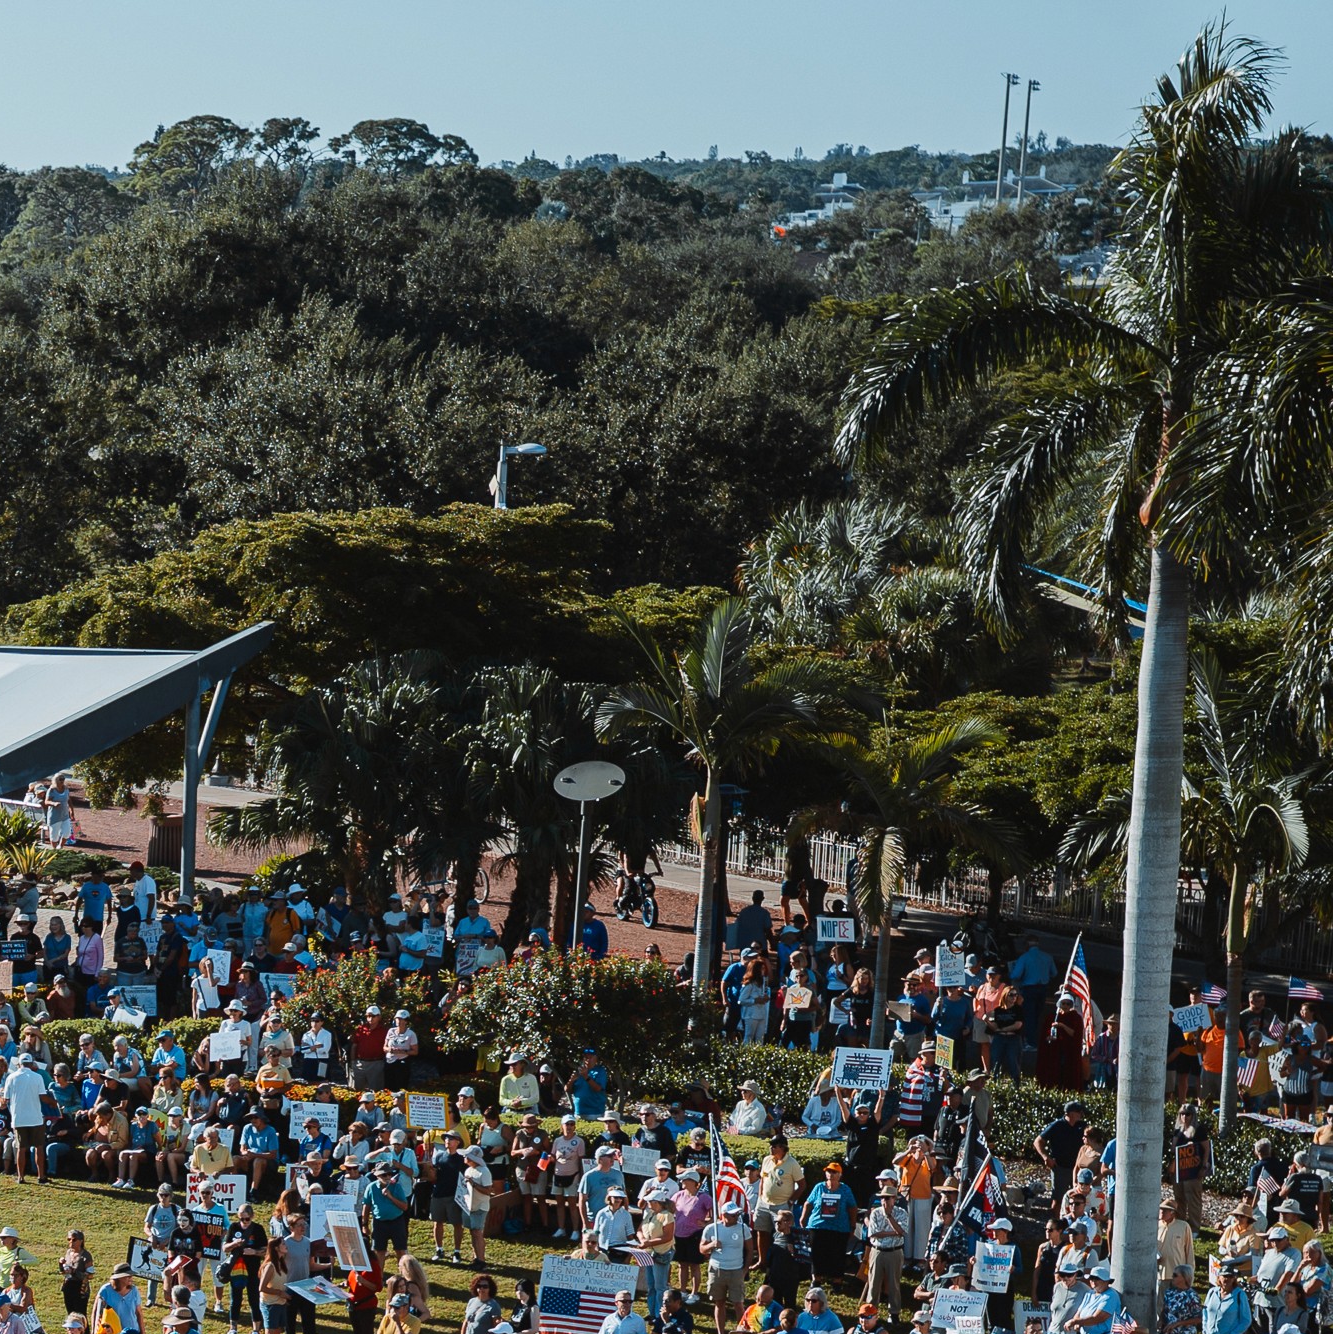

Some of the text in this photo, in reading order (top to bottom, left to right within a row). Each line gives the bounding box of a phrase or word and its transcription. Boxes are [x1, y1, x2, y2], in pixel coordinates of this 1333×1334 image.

[1177, 1006, 1203, 1021] GOOD
[835, 1076, 867, 1088] STAND
[1179, 1146, 1195, 1159] NO
[188, 1194, 198, 1204] A
[211, 1215, 224, 1227] OFF
[207, 1223, 223, 1236] OUR
[550, 1256, 632, 1275] THE CONSTITUTION
[545, 1272, 630, 1289] RESISTING KINGS SINCE
[551, 1266, 638, 1282] IS NOT SUGGESTION
[949, 1304, 969, 1315] NOT
[961, 1319, 982, 1330] LOVE
